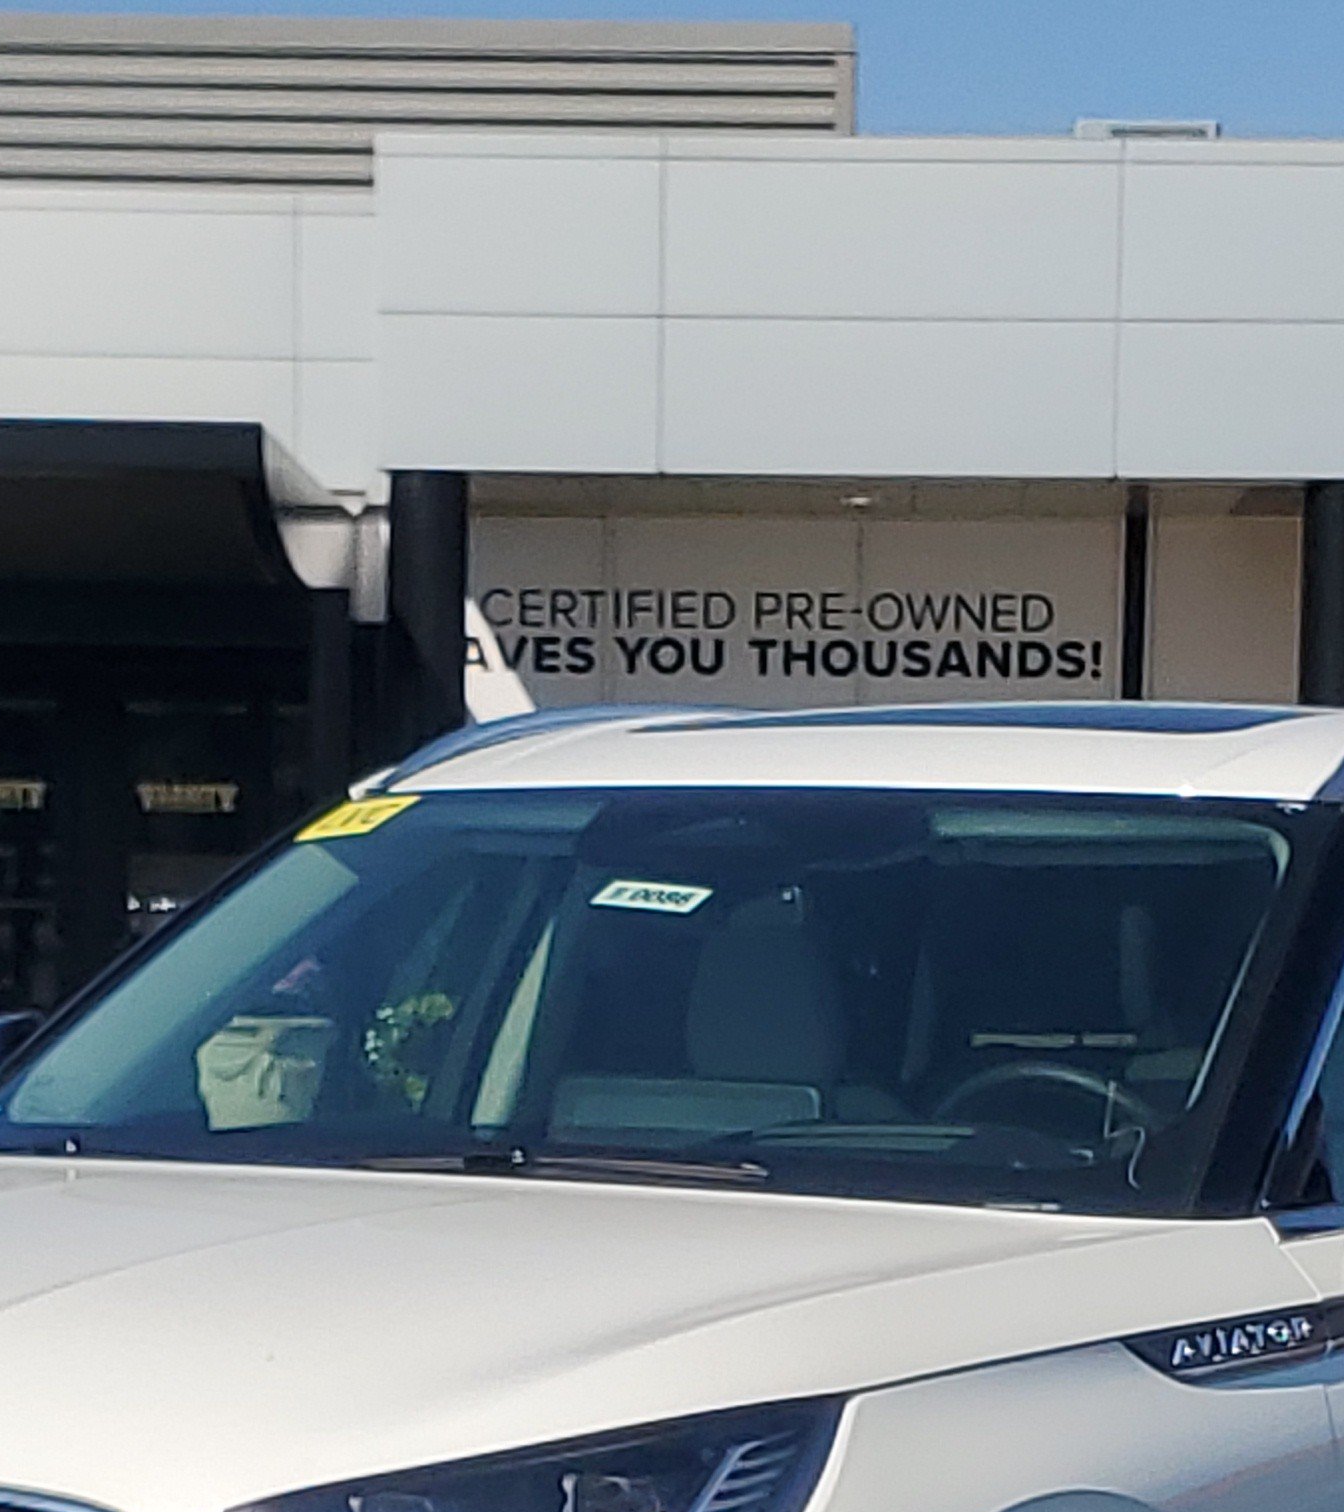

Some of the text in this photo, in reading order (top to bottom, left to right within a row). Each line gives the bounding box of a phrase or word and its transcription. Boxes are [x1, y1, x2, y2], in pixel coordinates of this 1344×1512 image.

[481, 588, 1055, 633] CERTIFIED PRE-OWNED
[613, 637, 725, 674] YOU
[748, 640, 1102, 679] THOUSANDS!
[1171, 1315, 1314, 1367] AVIATOR
